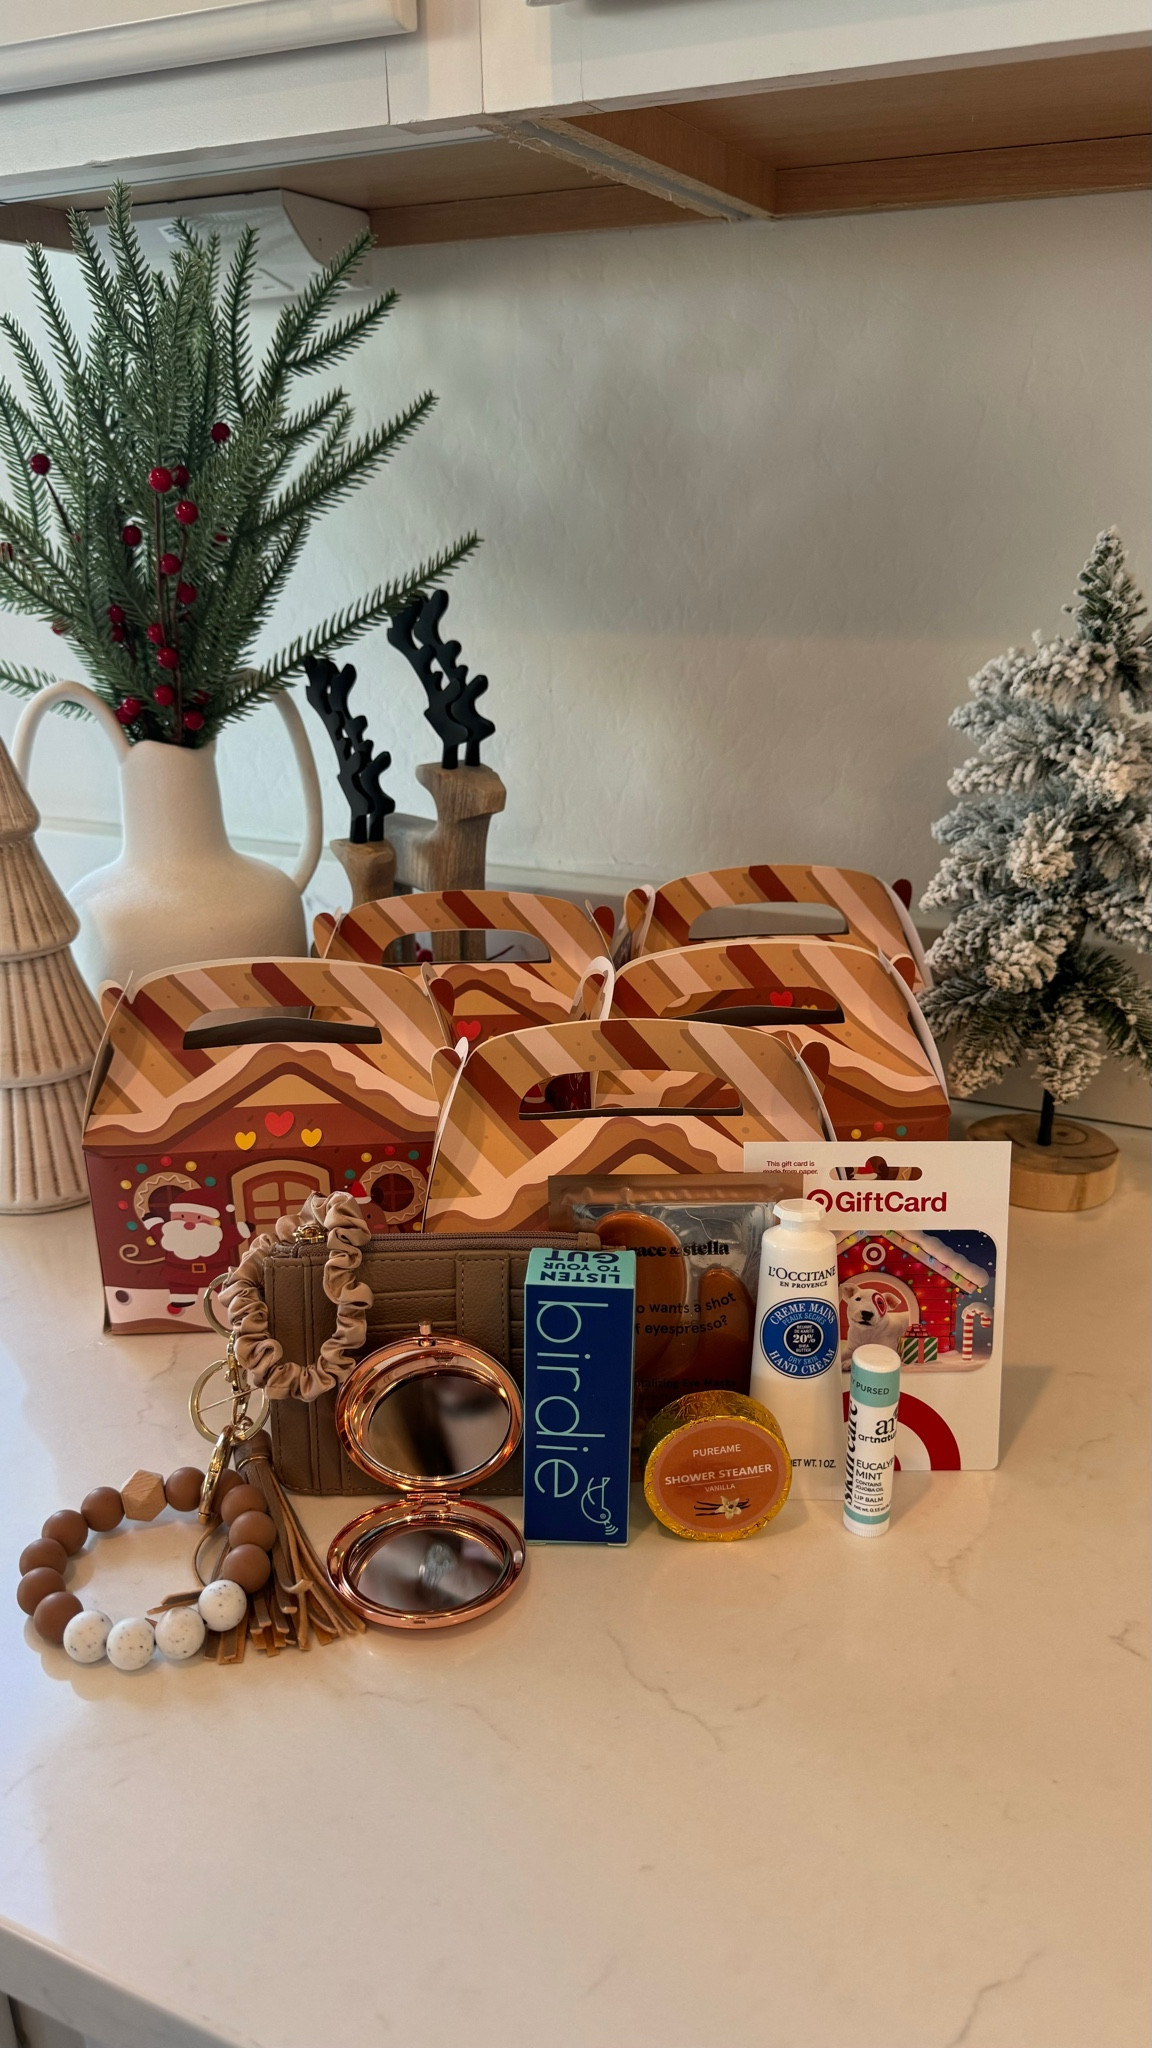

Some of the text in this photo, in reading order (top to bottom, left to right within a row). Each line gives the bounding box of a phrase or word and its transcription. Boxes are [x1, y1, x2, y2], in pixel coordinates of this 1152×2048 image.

[781, 1160, 792, 1169] gift
[835, 1191, 947, 1213] GiftCard
[626, 1240, 730, 1257] race & stella
[545, 1251, 620, 1264] GUT
[543, 1262, 620, 1273] TO YOUR
[540, 1271, 620, 1284] LISTEN
[791, 1280, 828, 1289] PROVENCE
[649, 1303, 690, 1314] wants
[694, 1304, 702, 1312] a
[705, 1291, 737, 1311] shot
[781, 1313, 803, 1326] PEAUX
[809, 1302, 836, 1324] MAINS
[644, 1314, 728, 1337] eyespresso?
[792, 1333, 816, 1344] 20%
[769, 1348, 835, 1375] HAND CREAM
[788, 1355, 819, 1365] DRY SKIN
[856, 1381, 890, 1395] PURSED
[534, 1300, 609, 1498] birdie
[692, 1443, 742, 1458] PUREAME
[803, 1459, 817, 1468] WT.
[665, 1463, 772, 1486] SHOWER STEAMER
[855, 1469, 882, 1480] MINT
[704, 1483, 736, 1493] VANILLA
[855, 1479, 882, 1487] CONTAINS
[855, 1485, 876, 1493] JOJOBA
[854, 1493, 864, 1501] LIP
